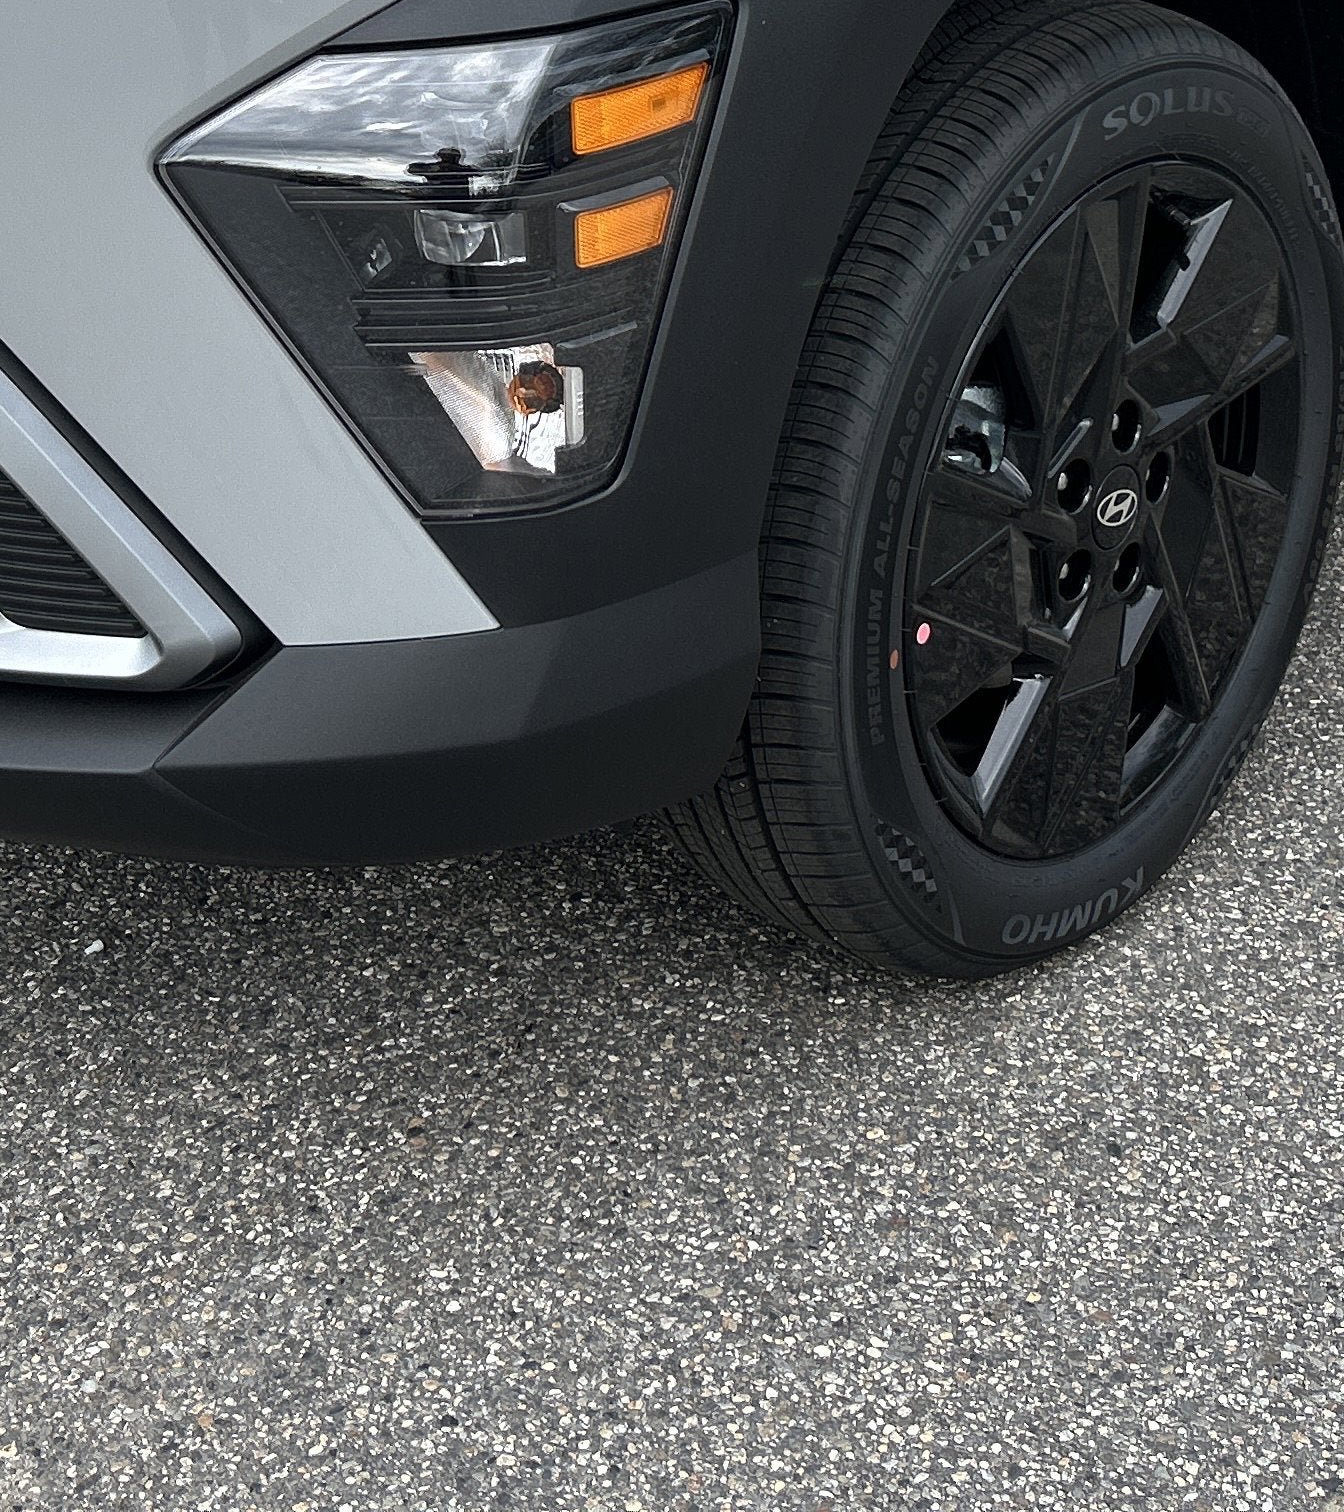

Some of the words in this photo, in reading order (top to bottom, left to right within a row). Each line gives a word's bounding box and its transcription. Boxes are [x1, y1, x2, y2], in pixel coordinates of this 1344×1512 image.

[1102, 86, 1234, 141] SOLUS
[871, 354, 940, 579] ALL-SEASON
[865, 587, 886, 747] PREMIUM
[1002, 866, 1144, 945] KUMHO
